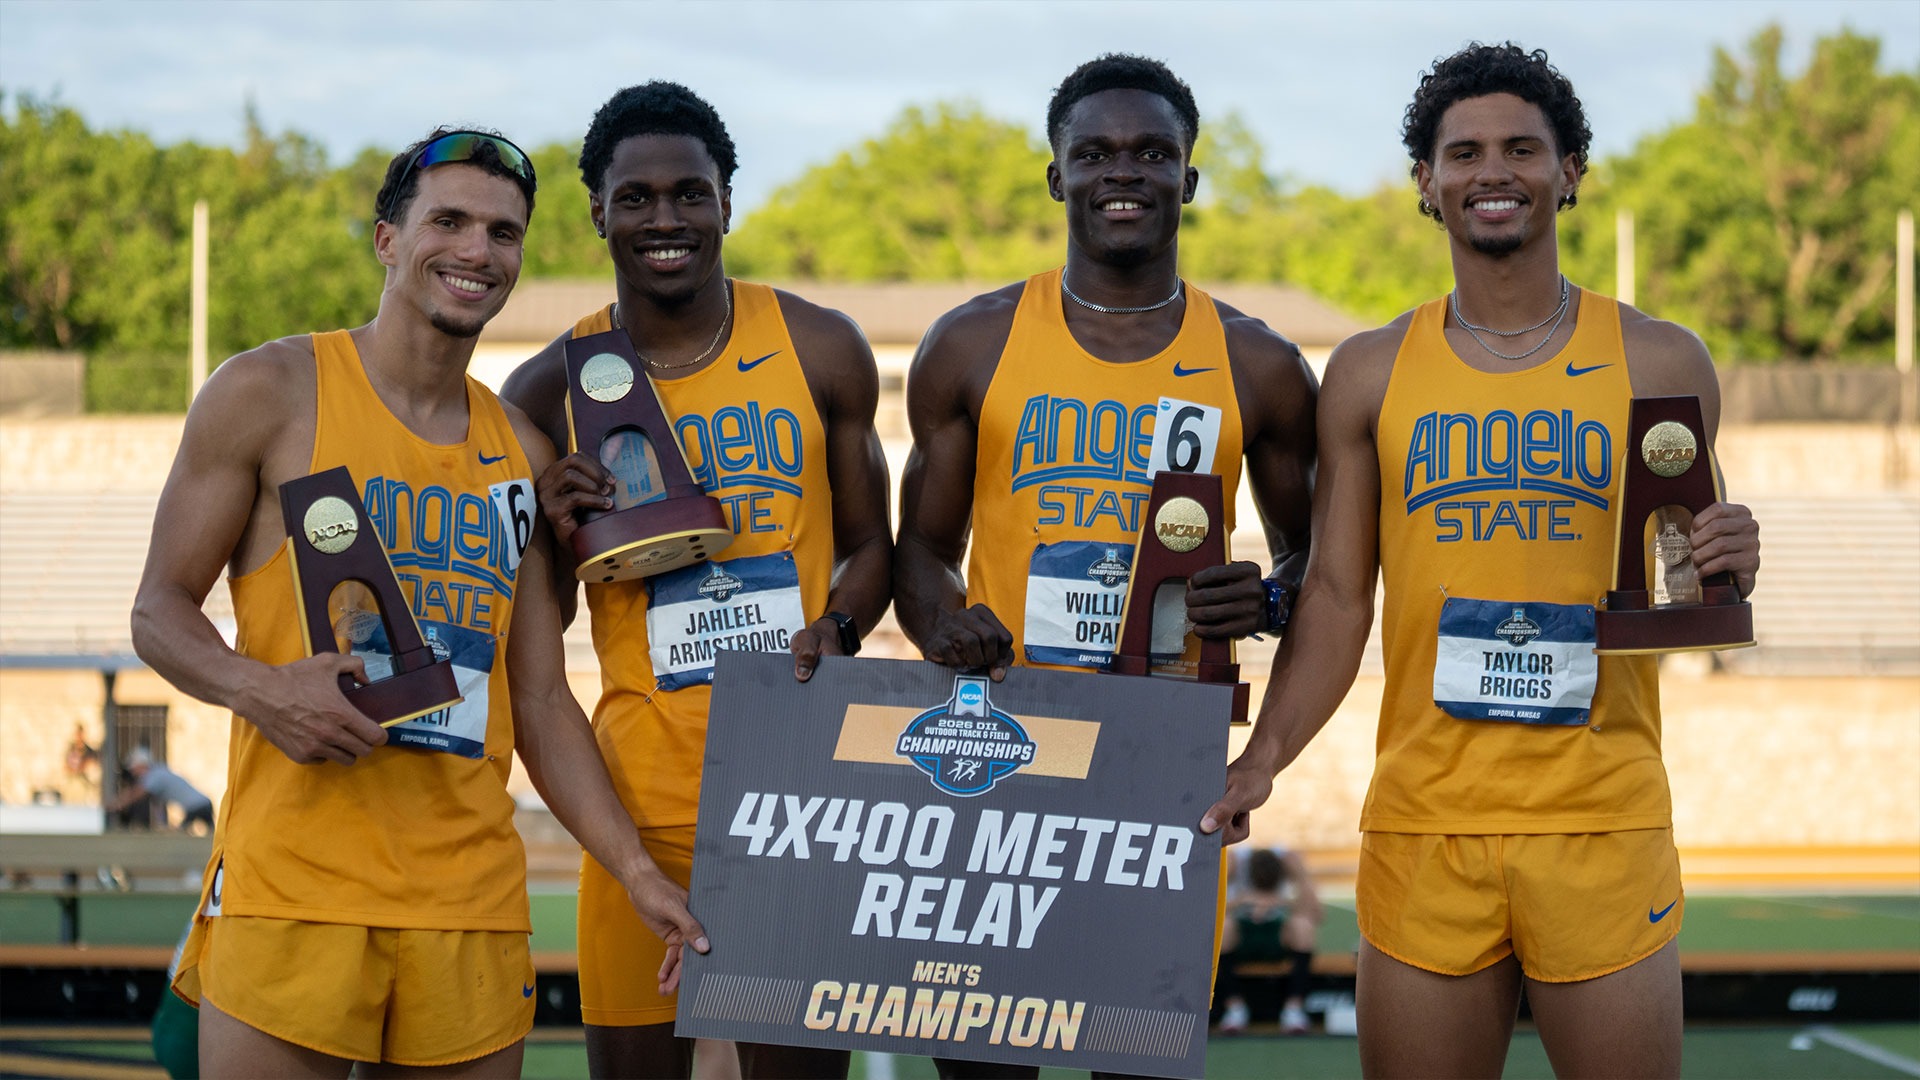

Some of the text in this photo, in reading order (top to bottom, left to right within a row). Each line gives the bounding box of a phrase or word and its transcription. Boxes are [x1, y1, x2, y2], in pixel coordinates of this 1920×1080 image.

[674, 401, 803, 493] gelo
[1012, 394, 1158, 482] Ange
[1166, 406, 1205, 473] 6
[1404, 409, 1612, 499] Angelo
[1647, 447, 1694, 463] NCAA
[1038, 485, 1150, 533] STAT
[311, 519, 358, 544] NCAA
[507, 484, 531, 560] 6
[1159, 522, 1206, 540] NCAA
[397, 573, 494, 629] TATE
[1066, 592, 1126, 616] WILLI
[685, 604, 766, 636] JAHLEEL
[1076, 621, 1120, 645] OPA
[669, 628, 791, 667] ARMSTRONG
[1482, 651, 1553, 675] TAYLOR
[960, 692, 981, 701] NCAA
[1480, 676, 1552, 700] BRIGGS
[938, 719, 998, 731] 2026 DII
[1488, 708, 1541, 719] EMPORIA, KANSAS
[429, 737, 449, 747] KANSAS
[924, 727, 1010, 741] OUTDOOR TRACK & FIELD
[899, 736, 1033, 761] CHAMPIONSHIPS
[728, 793, 1194, 891] 4X400 METER
[851, 872, 1061, 949] RELAY
[912, 961, 982, 986] MEN'S
[803, 981, 1086, 1051] CHAMPION
